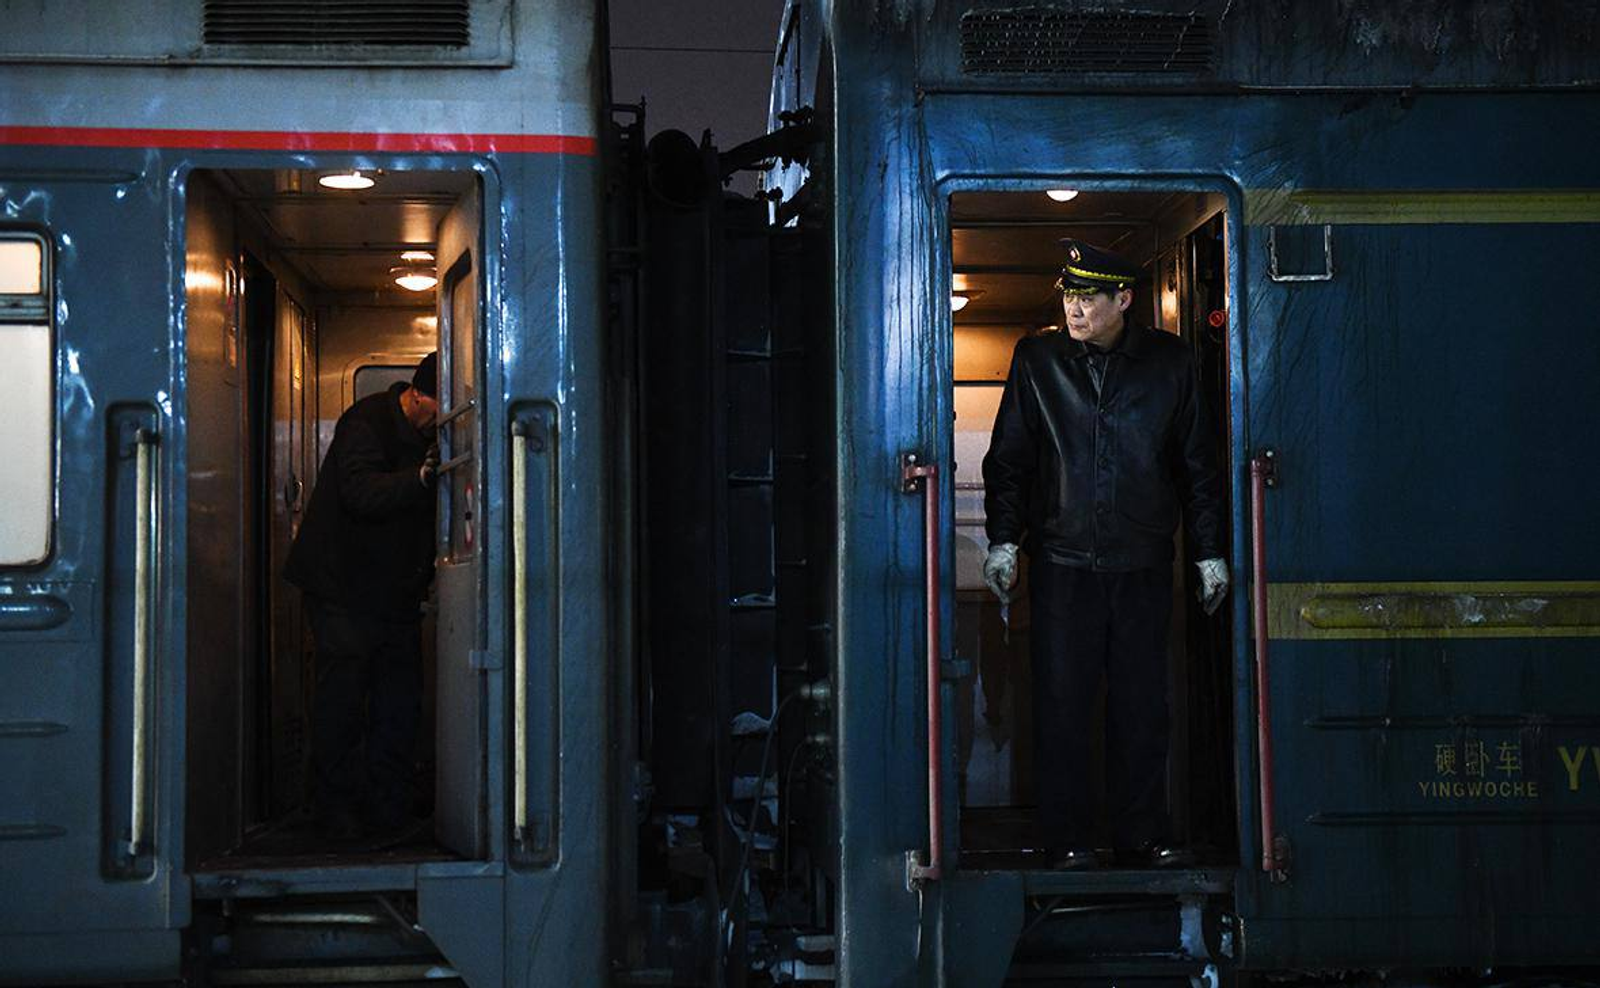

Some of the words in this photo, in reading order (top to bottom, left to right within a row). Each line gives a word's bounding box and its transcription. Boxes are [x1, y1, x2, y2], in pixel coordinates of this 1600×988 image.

[1434, 740, 1522, 778] 硬卧车
[1556, 746, 1600, 792] Y
[1418, 781, 1539, 798] YINGWOCHE
